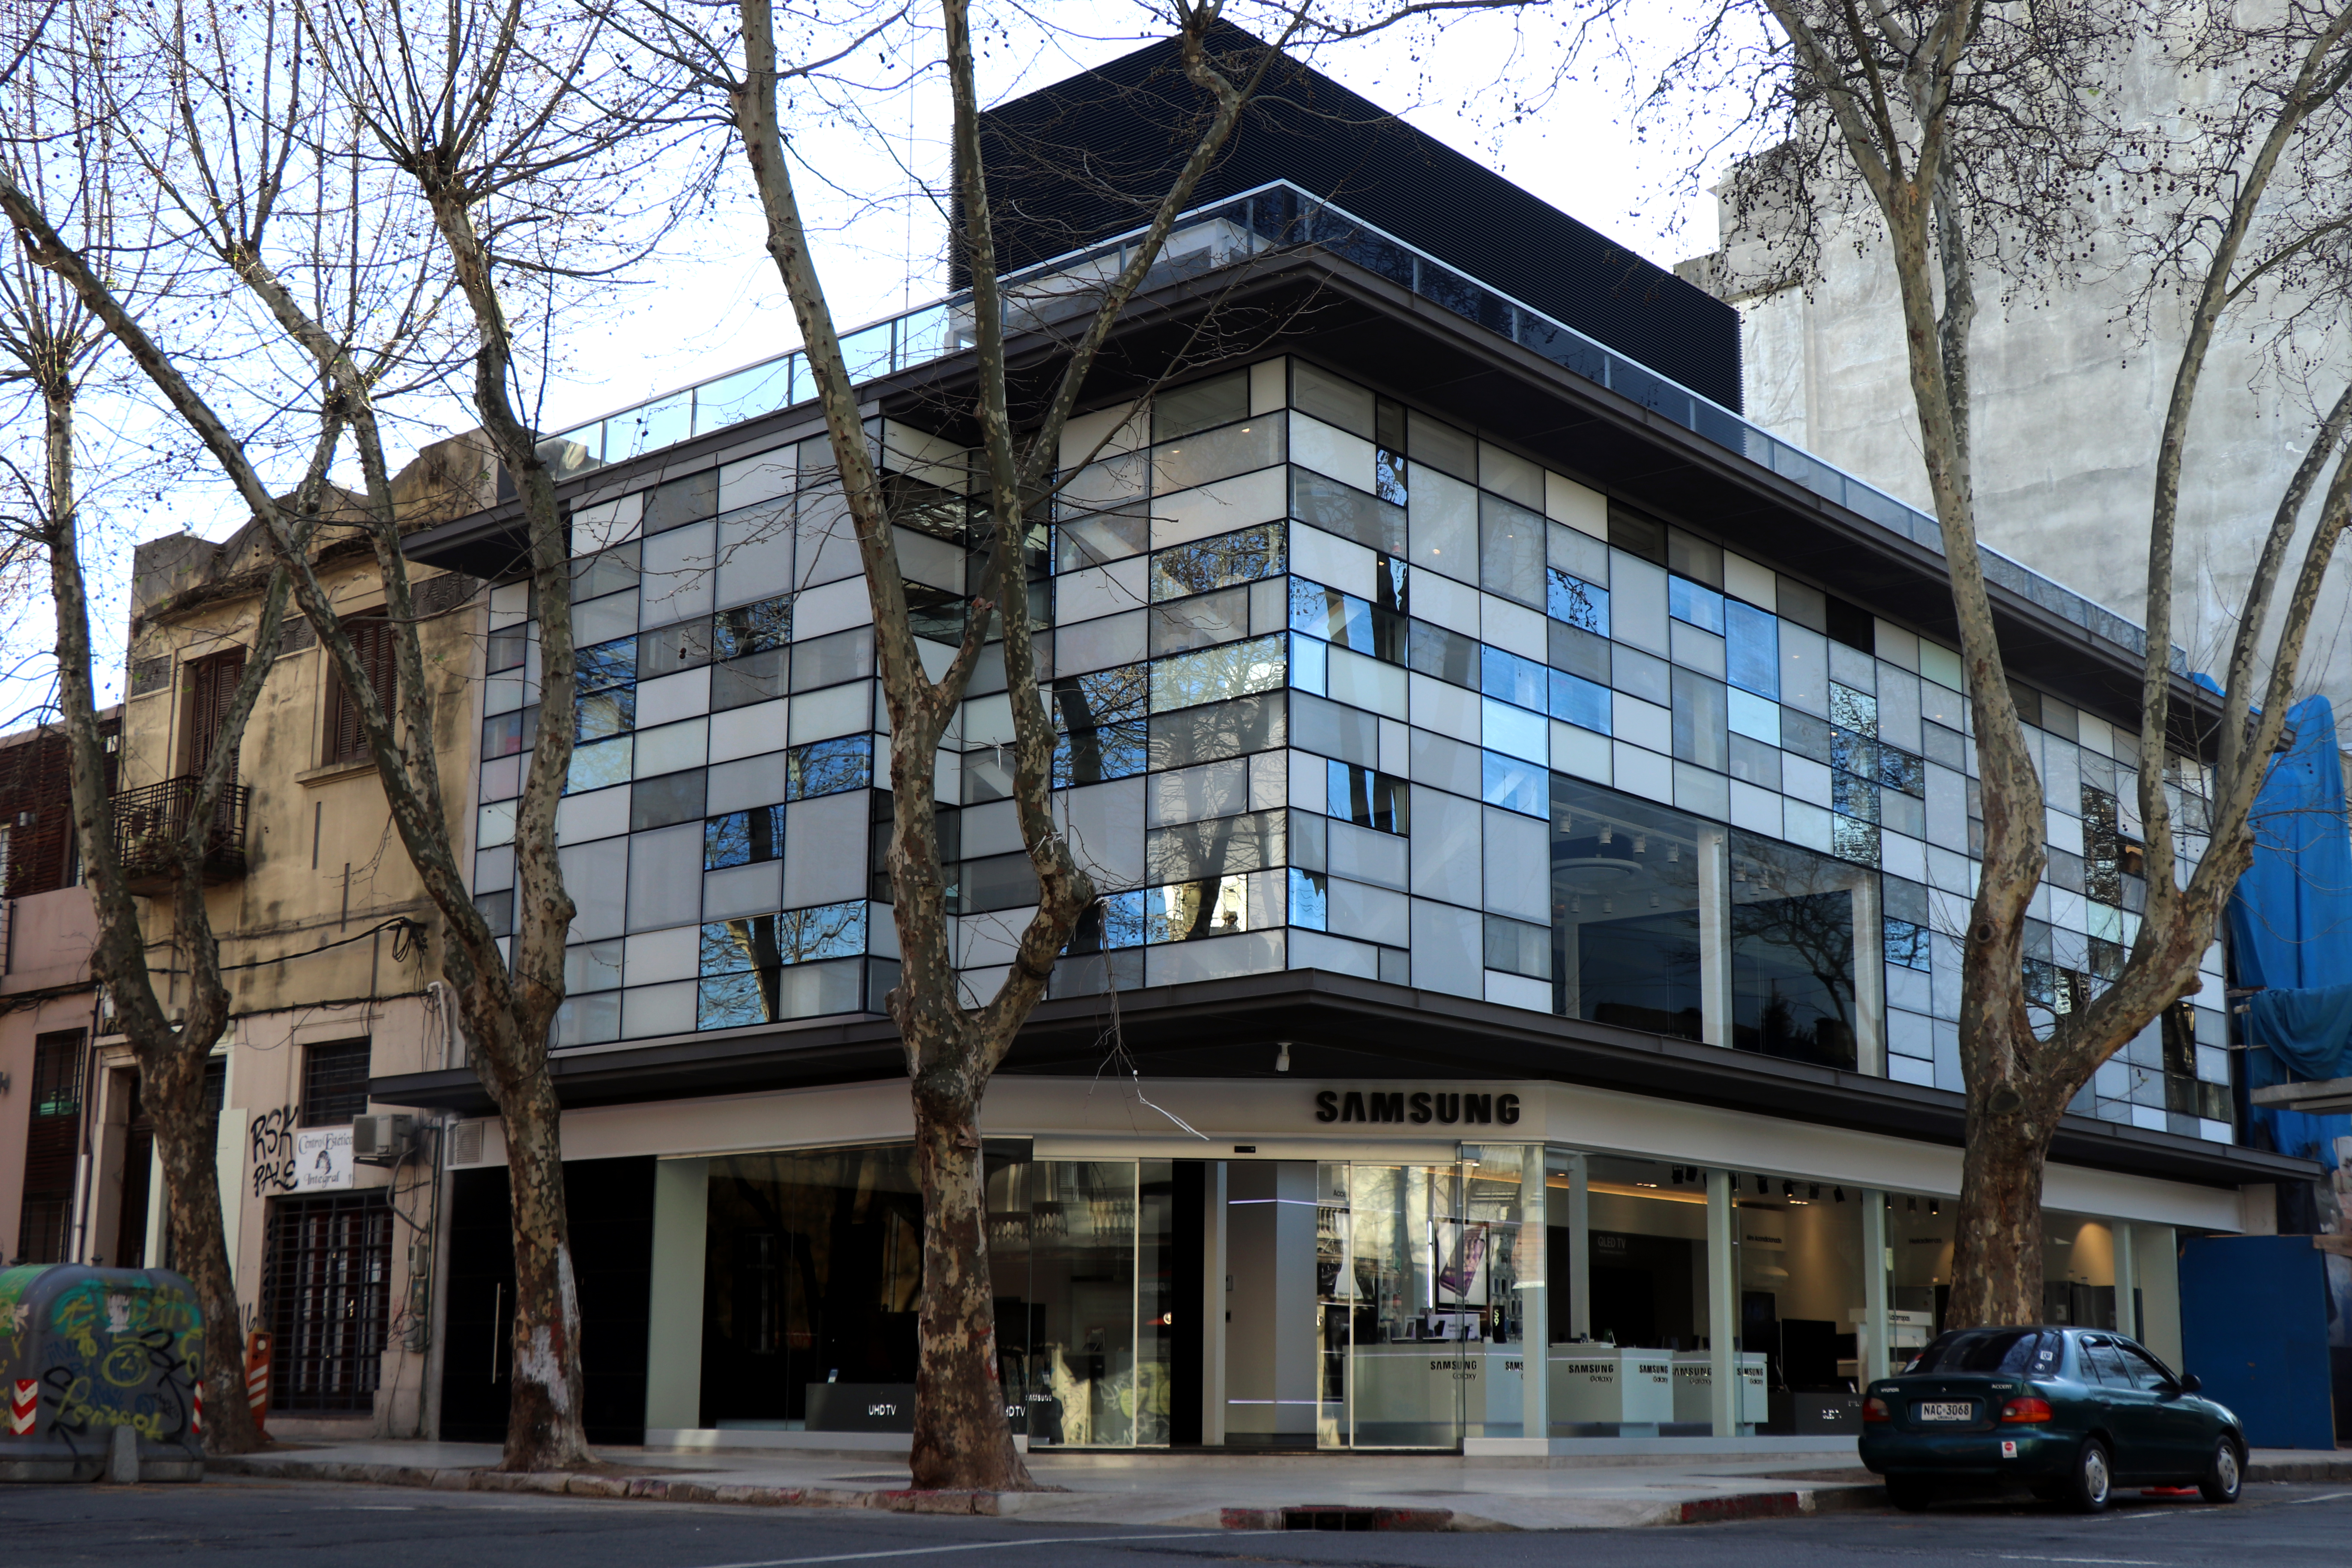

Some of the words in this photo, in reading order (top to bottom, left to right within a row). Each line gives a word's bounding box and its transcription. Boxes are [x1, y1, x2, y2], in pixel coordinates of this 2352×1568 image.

[1317, 1090, 1520, 1125] SAMSUNG
[299, 1135, 321, 1154] Centro
[304, 1171, 340, 1188] Integral
[1598, 1236, 1616, 1248] QLED
[1617, 1238, 1625, 1249] TV
[1494, 1309, 1499, 1326] S9
[1430, 1361, 1477, 1370] SAMSUNG
[1569, 1364, 1614, 1373] SAMSUNG
[1639, 1365, 1668, 1373] SAMSUNG
[1737, 1368, 1763, 1376] SMSUNG
[1924, 1405, 1942, 1415] NAC
[1947, 1404, 1969, 1415] 3068
